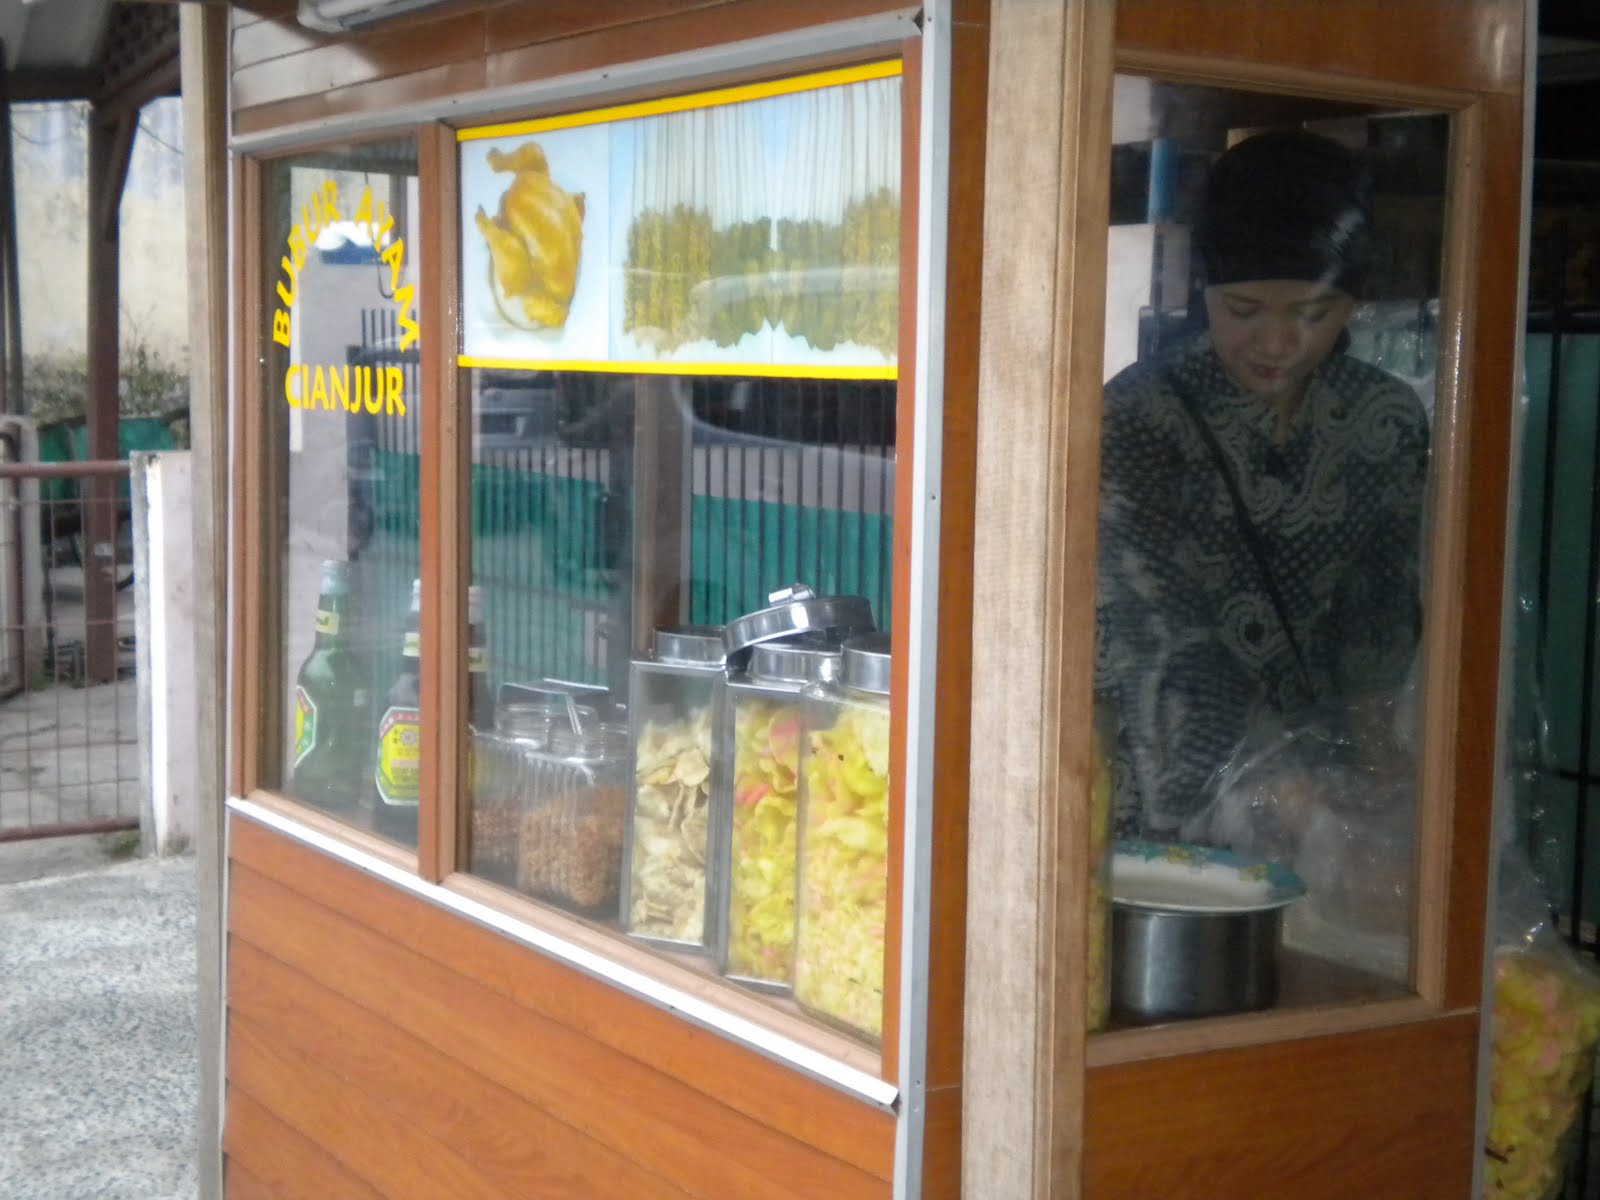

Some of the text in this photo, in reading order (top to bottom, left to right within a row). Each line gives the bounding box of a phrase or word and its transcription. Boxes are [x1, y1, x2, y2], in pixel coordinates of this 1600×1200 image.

[272, 180, 420, 353] BUBUR AYAM
[285, 364, 406, 416] CIANJUR
